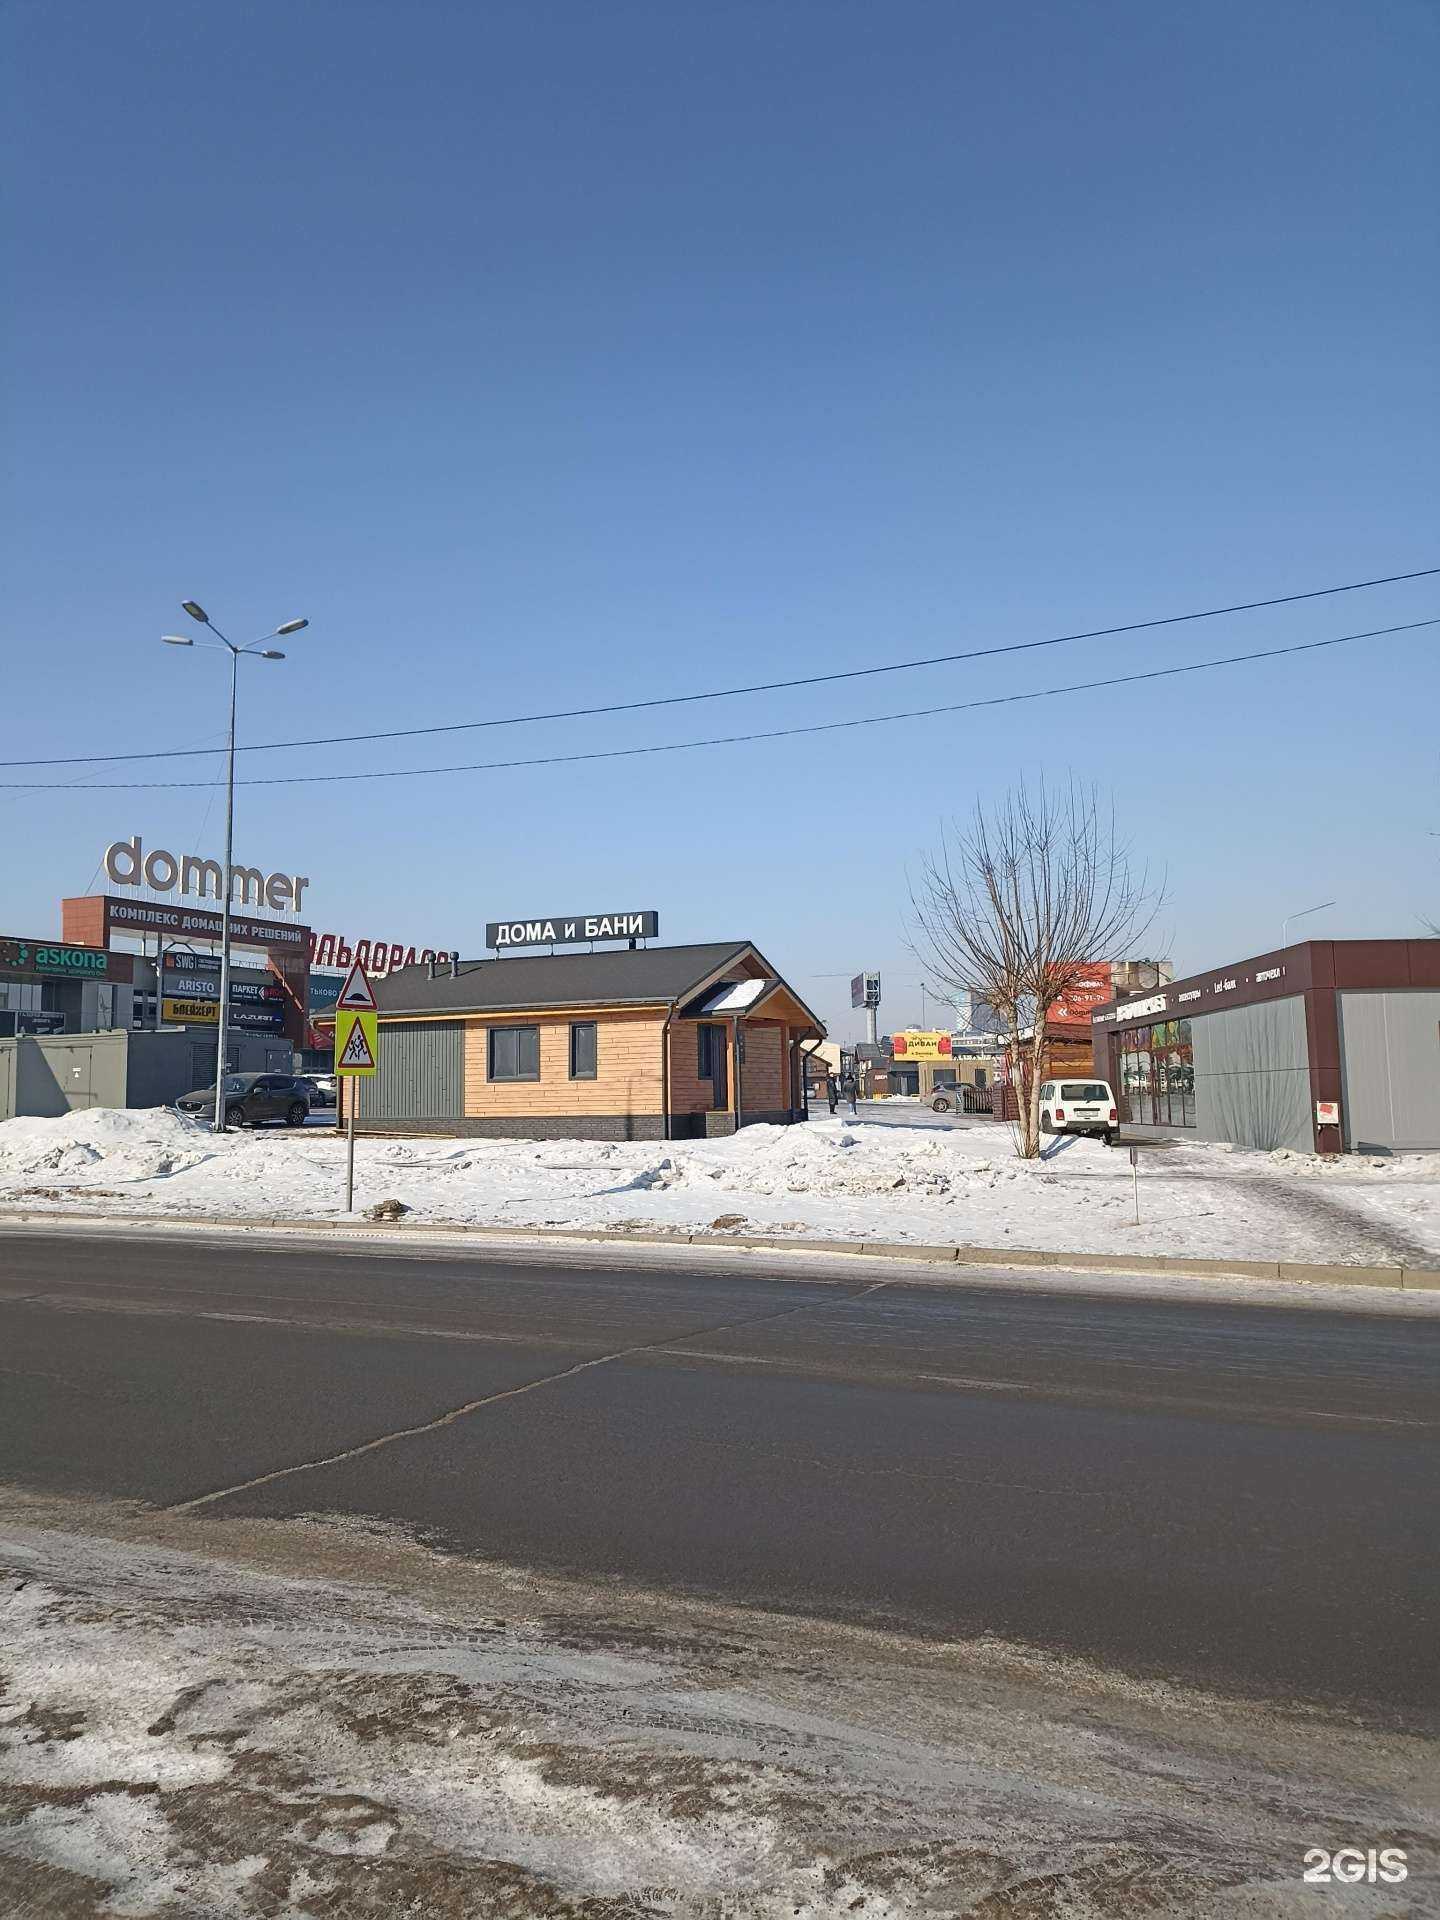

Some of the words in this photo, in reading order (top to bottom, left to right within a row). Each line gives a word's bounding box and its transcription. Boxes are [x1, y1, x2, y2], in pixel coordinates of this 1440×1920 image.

[104, 835, 308, 912] dommer
[110, 905, 178, 926] КОМПЛЕКС
[251, 926, 301, 943] РЕШЕНИЙ
[495, 921, 556, 945] ДОМА
[564, 922, 575, 939] и
[585, 914, 643, 937] БАНИ
[35, 948, 108, 969] askona
[175, 954, 194, 969] SWG
[178, 979, 215, 993] ARISTO
[232, 984, 258, 995] ПАРКЕТ
